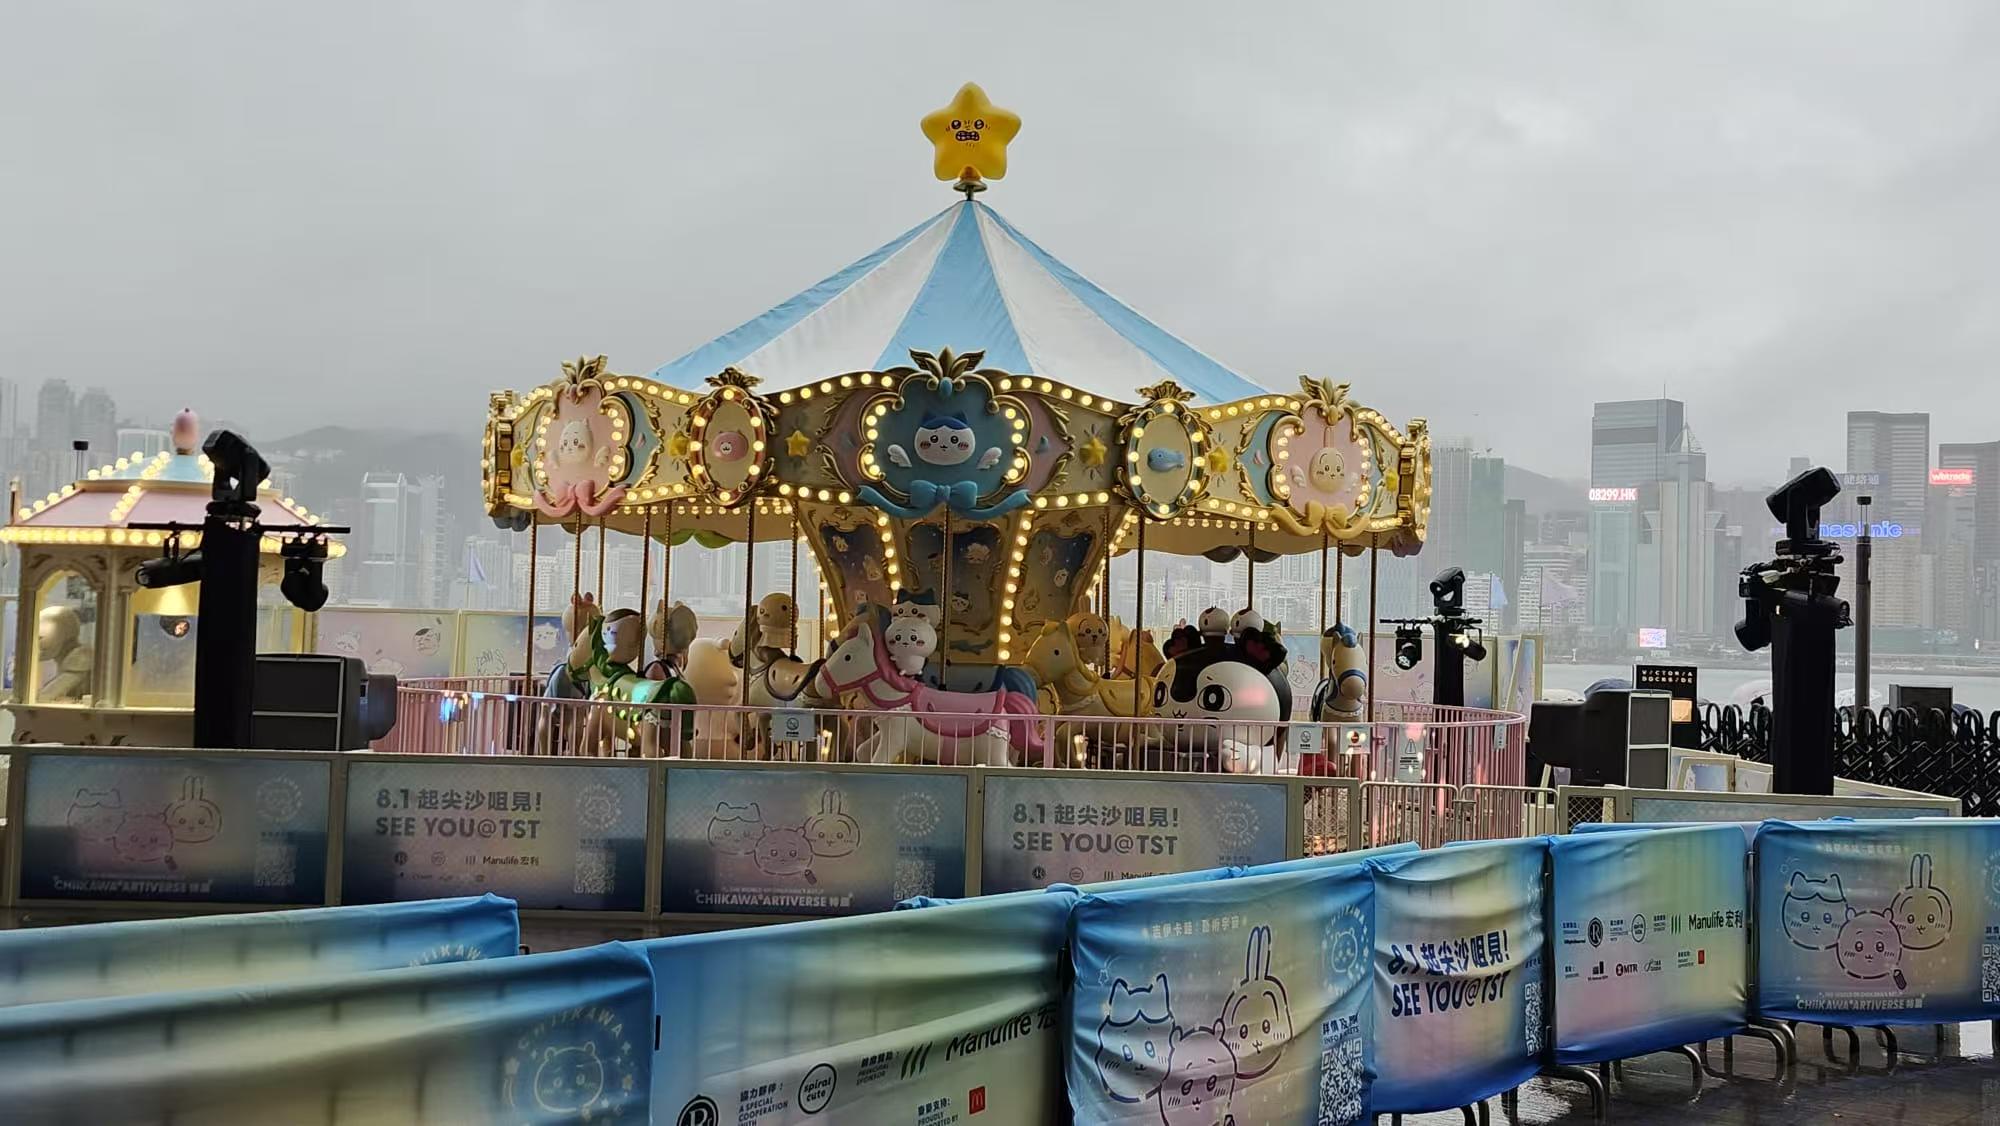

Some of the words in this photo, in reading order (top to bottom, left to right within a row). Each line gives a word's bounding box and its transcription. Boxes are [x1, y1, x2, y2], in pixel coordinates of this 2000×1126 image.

[376, 788, 410, 809] 8.1
[1013, 803, 1046, 824] 8.1
[376, 816, 416, 837] SEE
[424, 817, 541, 839] YOU@TST
[1013, 831, 1053, 851] SEE
[1060, 832, 1178, 855] YOU@TST
[1689, 911, 1724, 931] Manulife
[1391, 982, 1422, 1017] SEE
[1425, 970, 1511, 1013] YOU@TST
[804, 1077, 832, 1094] spiral
[806, 1090, 826, 1102] cute
[738, 1101, 789, 1122] COOPERATION
[745, 1097, 773, 1112] SPECIAL
